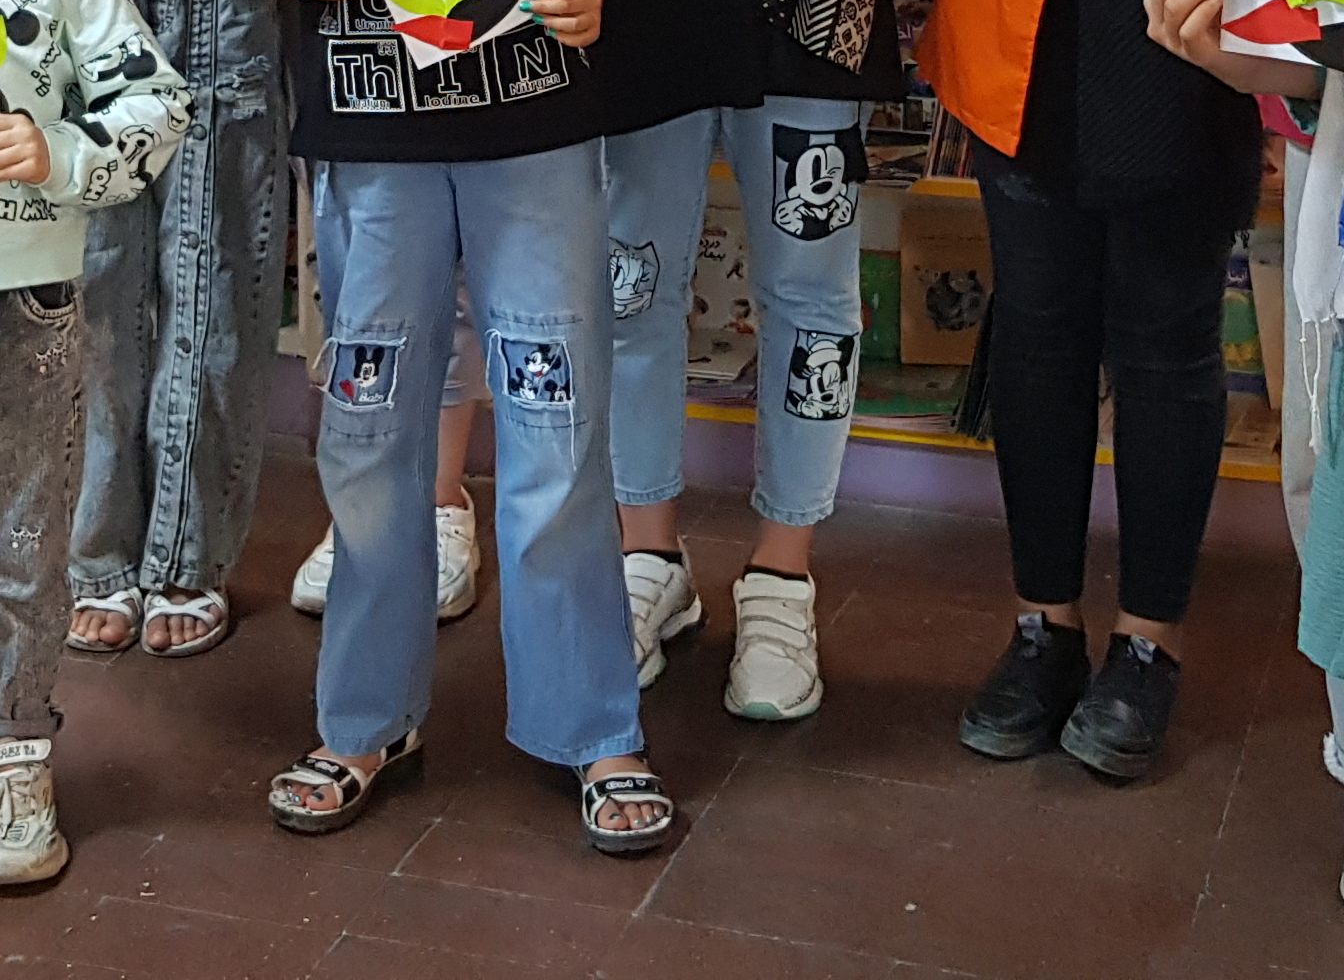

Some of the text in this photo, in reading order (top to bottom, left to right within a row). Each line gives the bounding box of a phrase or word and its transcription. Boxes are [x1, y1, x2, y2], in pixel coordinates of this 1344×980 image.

[334, 54, 398, 98] Th
[513, 36, 551, 82] N
[424, 92, 480, 108] Iodine
